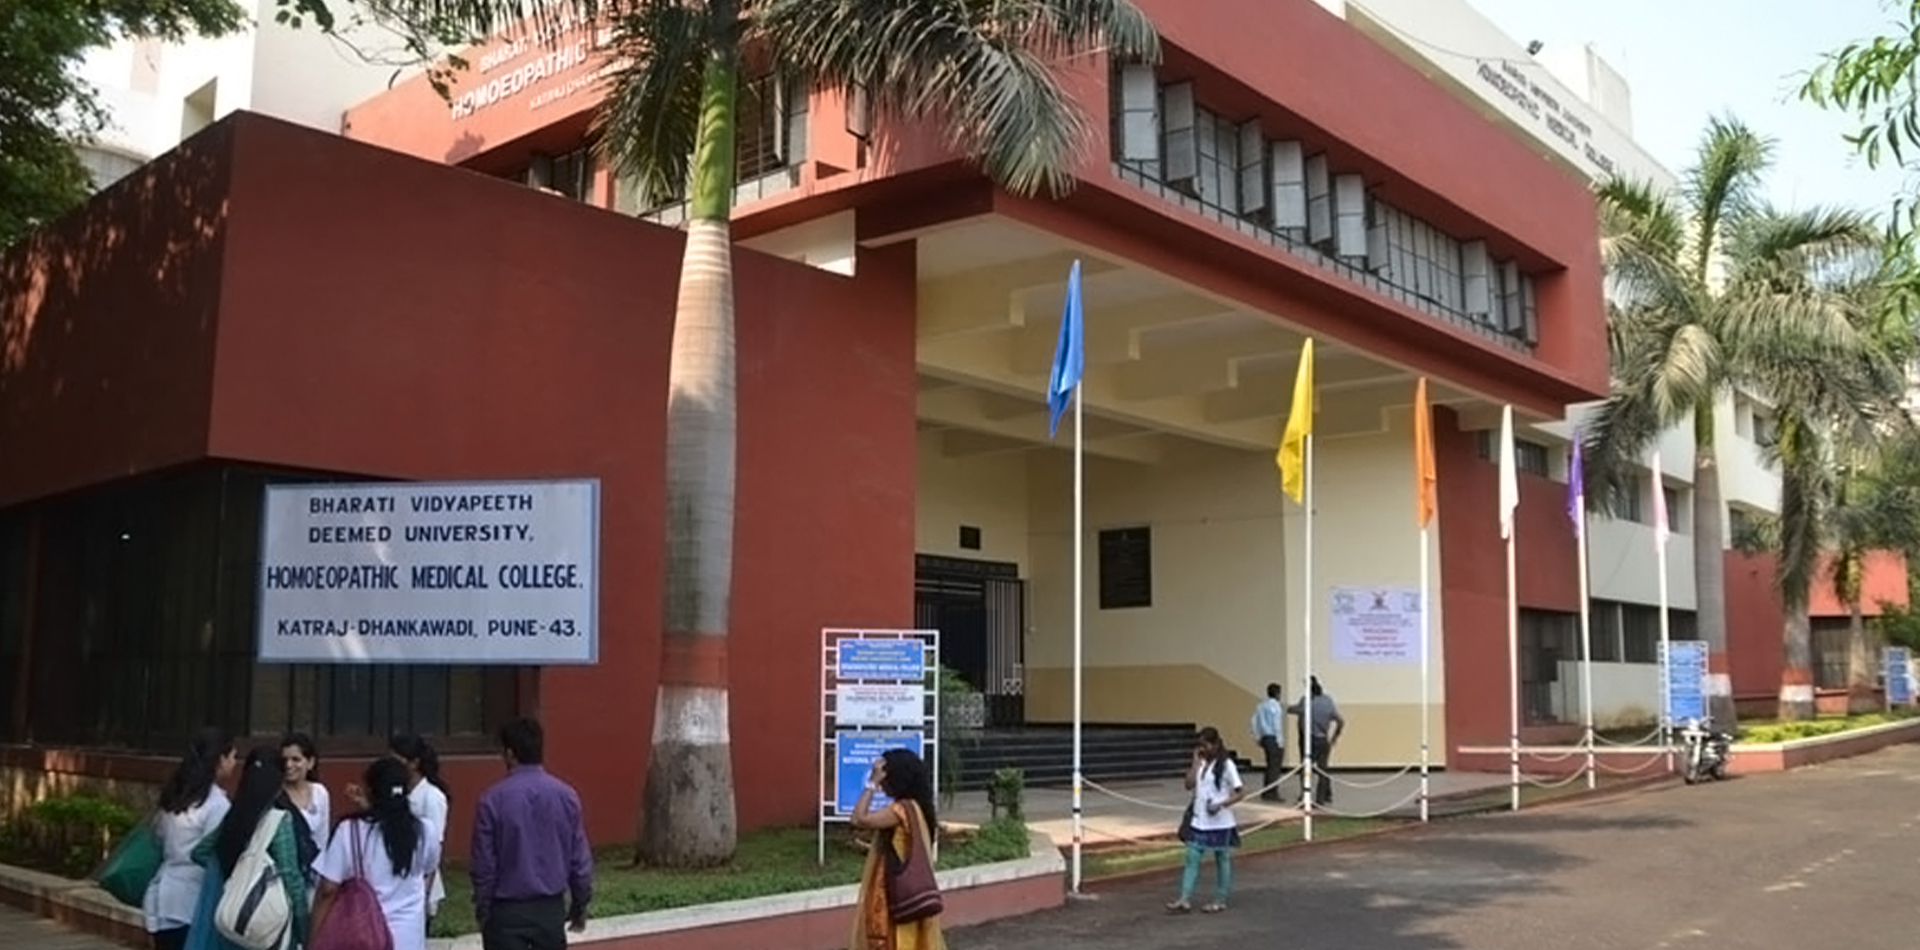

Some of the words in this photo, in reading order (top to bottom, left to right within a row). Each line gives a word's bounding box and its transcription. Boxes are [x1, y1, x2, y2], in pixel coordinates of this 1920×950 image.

[453, 38, 588, 119] HOMOEOPATHIC
[309, 497, 395, 514] BHARATI
[411, 494, 533, 513] VIDYAPEETH
[309, 526, 392, 544] DEEMED
[267, 565, 399, 590] HOMOEOPATHIC
[412, 565, 488, 589] MEDICAL
[498, 564, 584, 589] COLLEGE.
